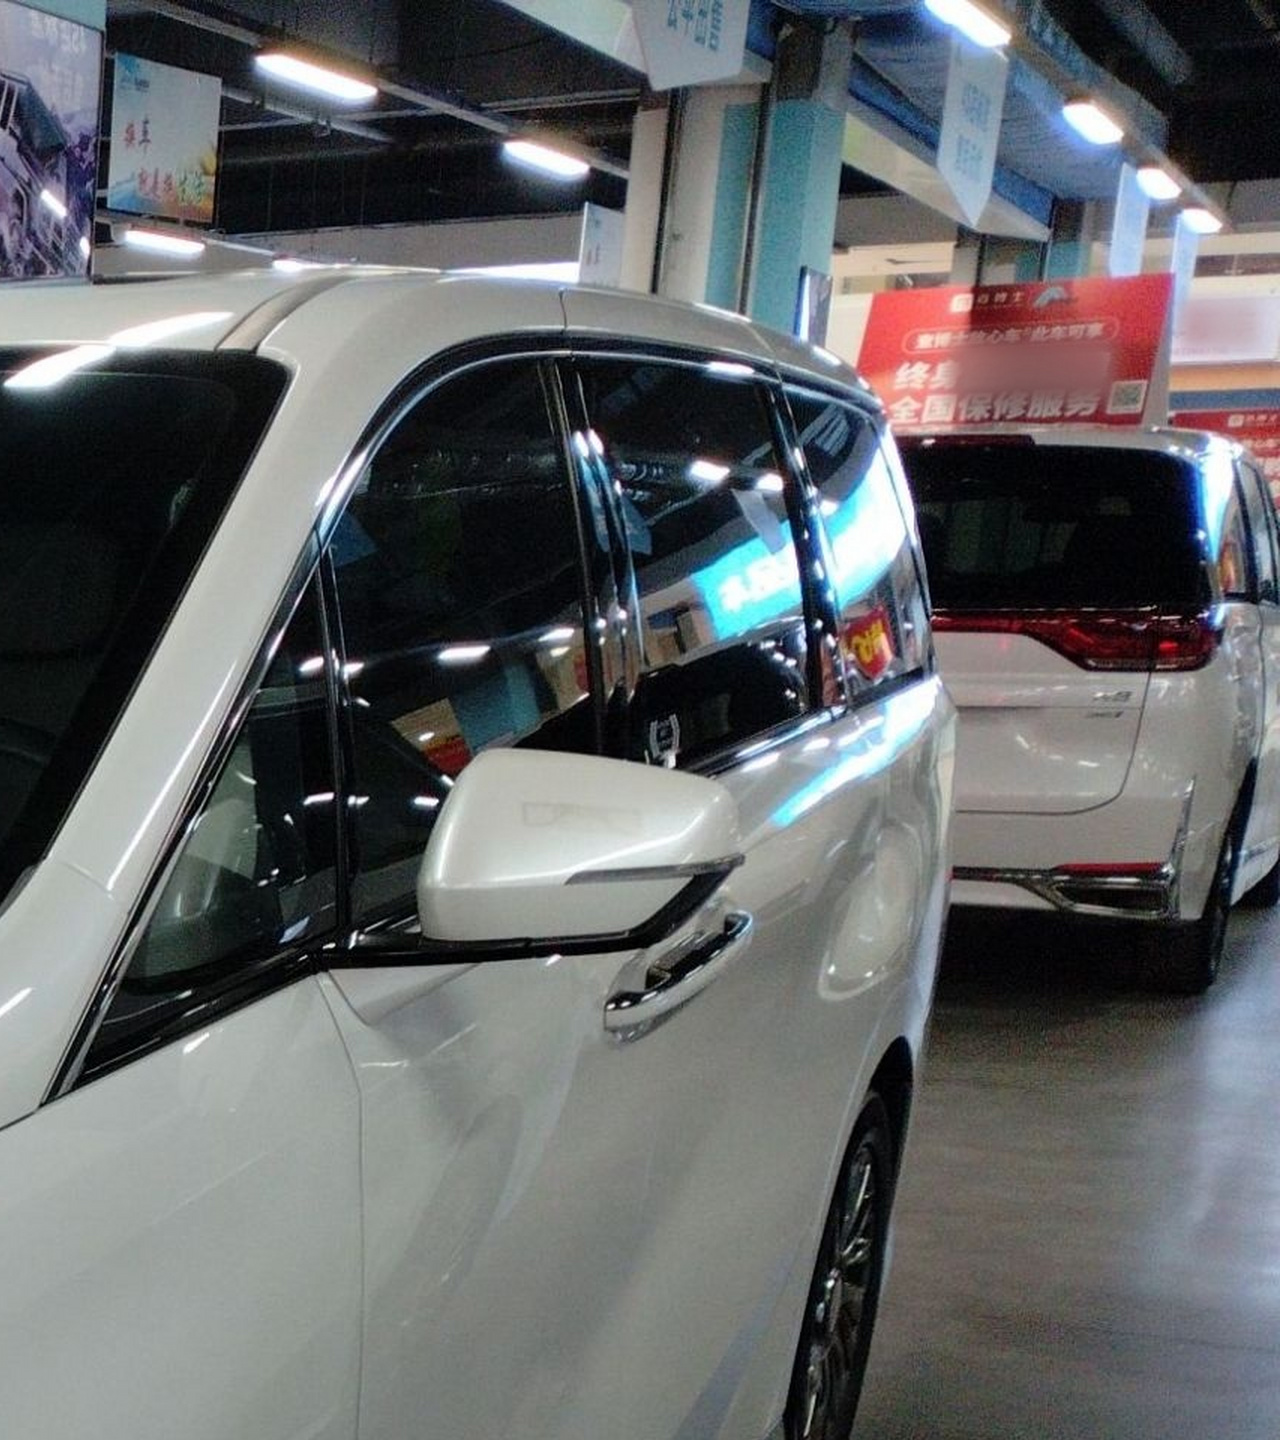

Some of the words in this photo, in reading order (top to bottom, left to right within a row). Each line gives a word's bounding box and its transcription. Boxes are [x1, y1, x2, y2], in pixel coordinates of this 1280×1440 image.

[888, 391, 1101, 425] 全国保修服务
